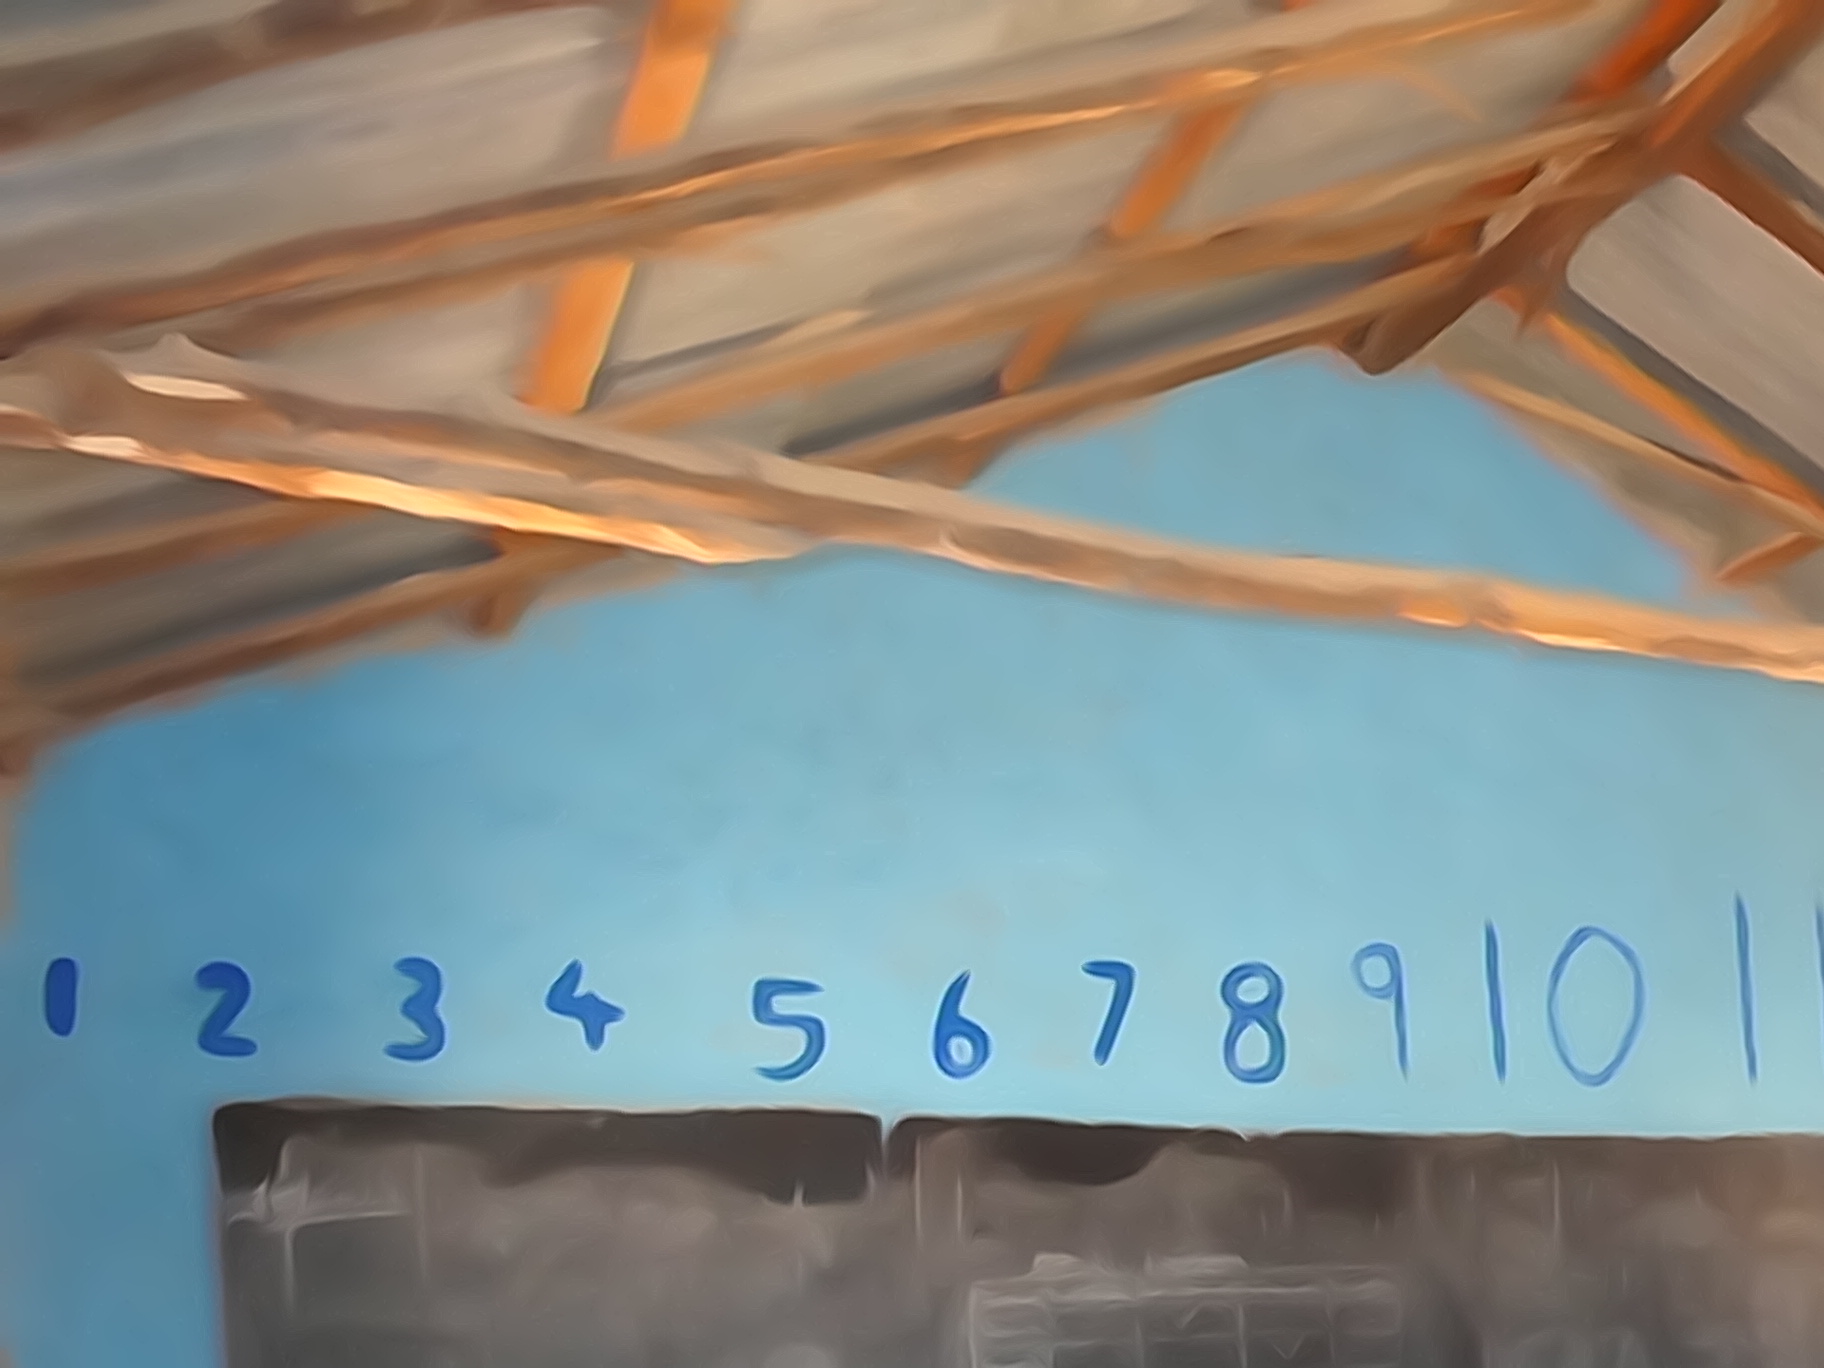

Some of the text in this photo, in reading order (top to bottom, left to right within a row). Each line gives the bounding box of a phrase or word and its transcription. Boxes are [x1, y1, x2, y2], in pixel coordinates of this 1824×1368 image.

[43, 957, 78, 1037] 1
[194, 961, 258, 1057] 2
[383, 957, 446, 1061] 3
[544, 959, 625, 1051] 4
[751, 977, 826, 1080] 5
[932, 969, 991, 1079] 6
[1080, 960, 1135, 1067] 7
[1220, 961, 1286, 1084] 8
[1351, 942, 1408, 1082] 9
[1484, 918, 1646, 1087] 10
